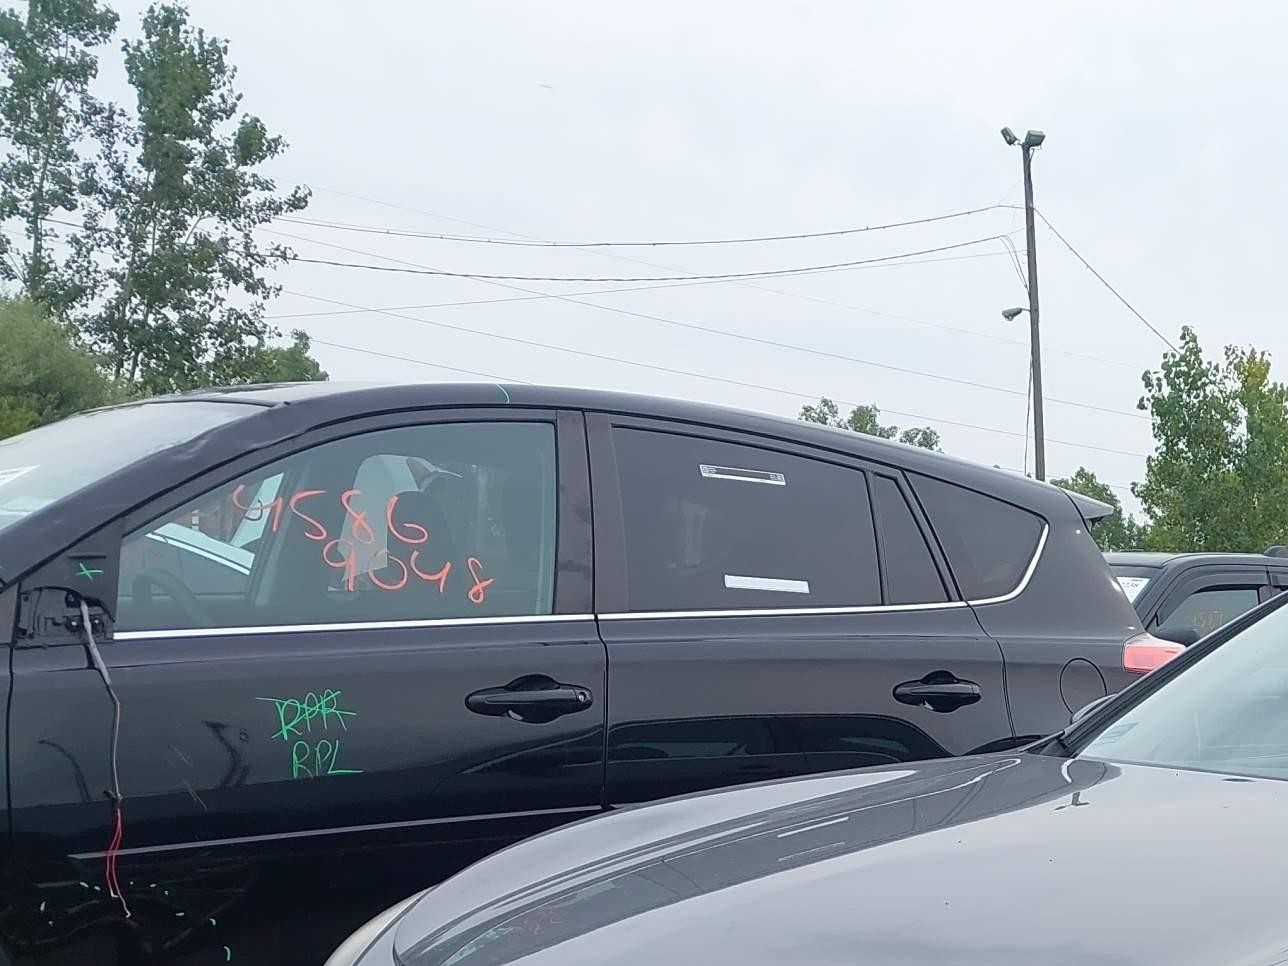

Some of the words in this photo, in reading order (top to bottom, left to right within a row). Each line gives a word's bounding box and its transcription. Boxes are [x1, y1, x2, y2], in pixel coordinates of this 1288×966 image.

[232, 484, 428, 544] 4586
[322, 537, 495, 604] 9048
[292, 739, 364, 779] RPL
